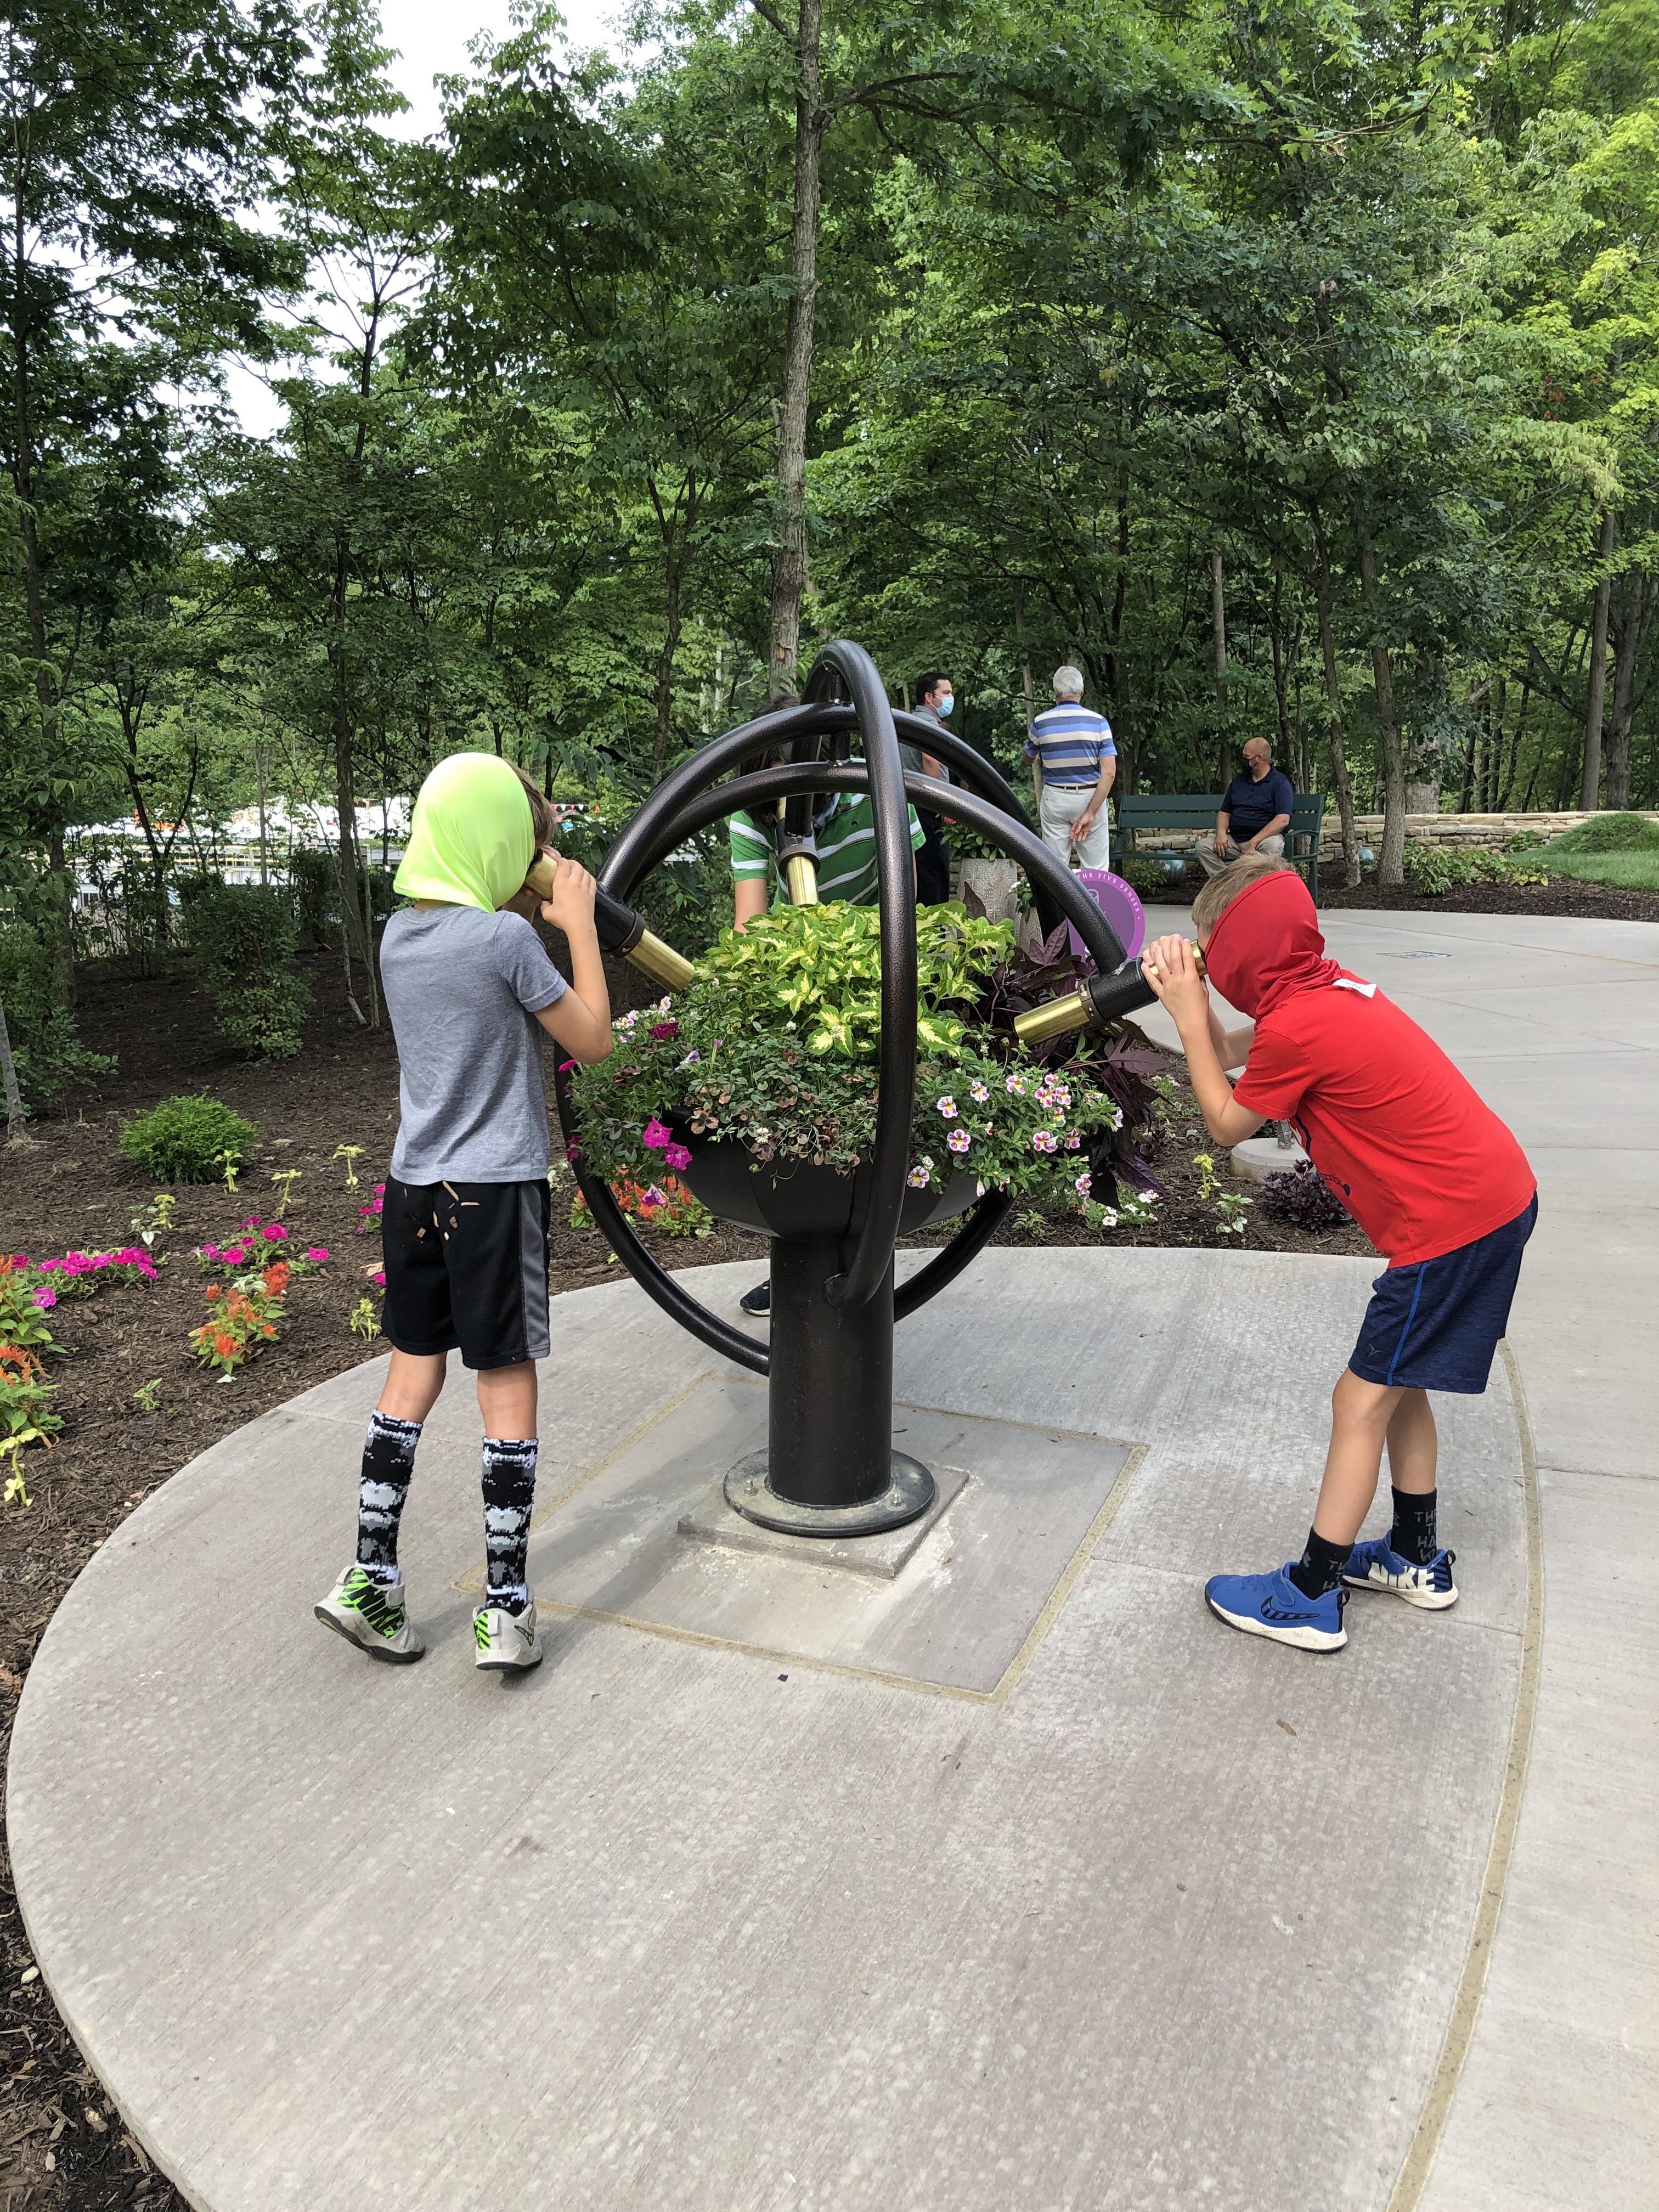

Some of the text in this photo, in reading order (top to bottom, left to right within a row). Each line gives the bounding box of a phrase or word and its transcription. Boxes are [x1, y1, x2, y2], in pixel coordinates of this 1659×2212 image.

[1098, 873, 1117, 884] FIVE
[1120, 883, 1140, 912] SENSES
[1368, 1562, 1435, 1591] NIKE
[347, 1584, 405, 1639] NIKE
